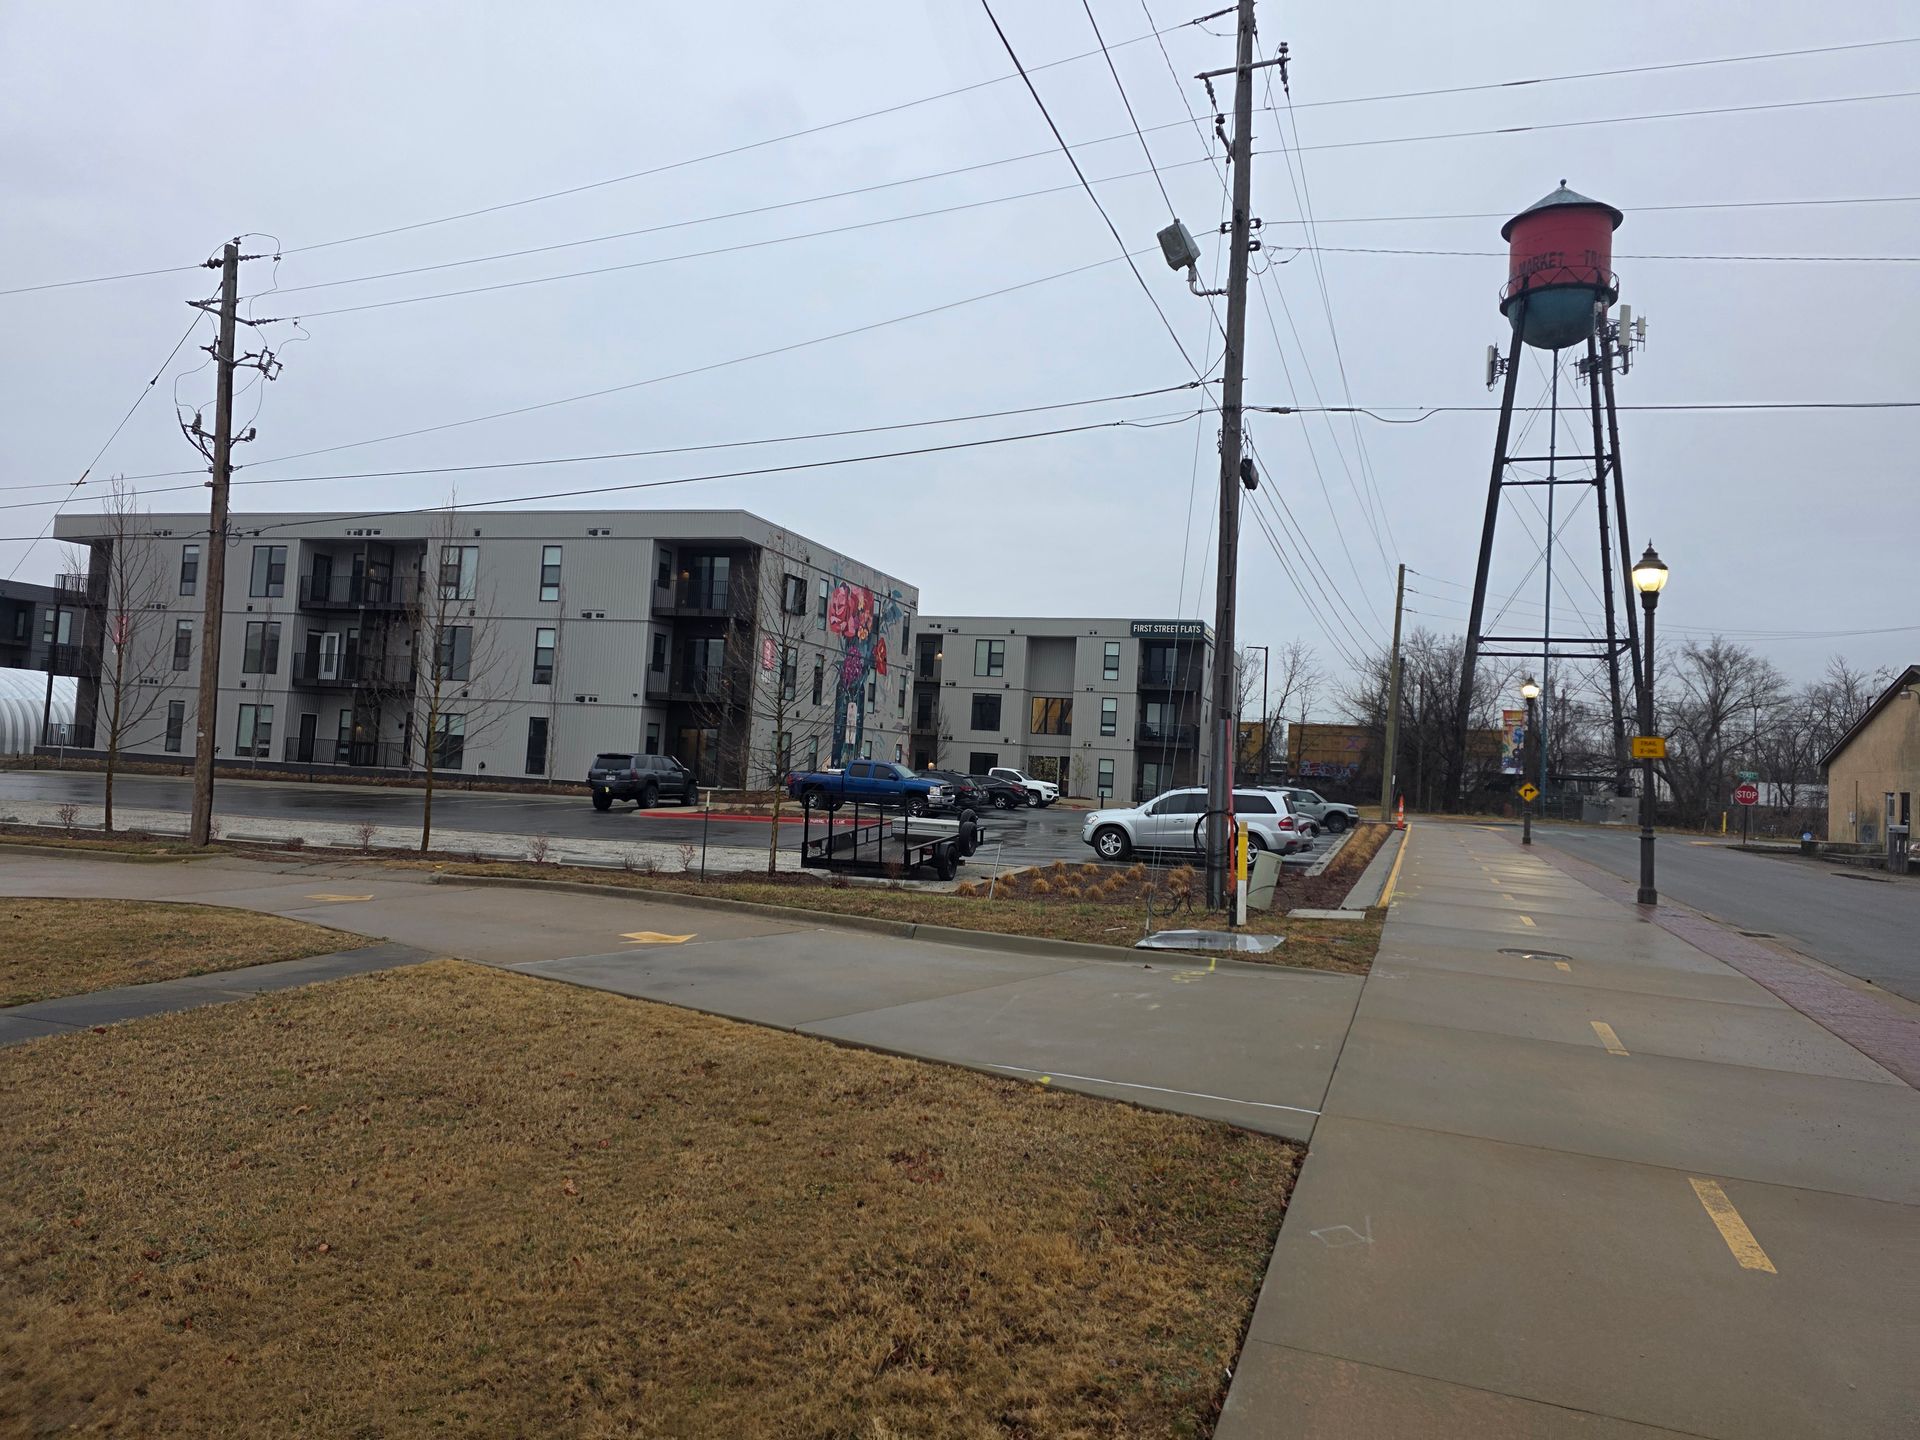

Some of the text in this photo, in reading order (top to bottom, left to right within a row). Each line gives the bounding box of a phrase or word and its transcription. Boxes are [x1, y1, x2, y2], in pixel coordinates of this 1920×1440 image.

[1519, 252, 1564, 273] MARKET
[1133, 625, 1201, 634] FIRST STREET FLATS
[1736, 790, 1758, 799] STOP
